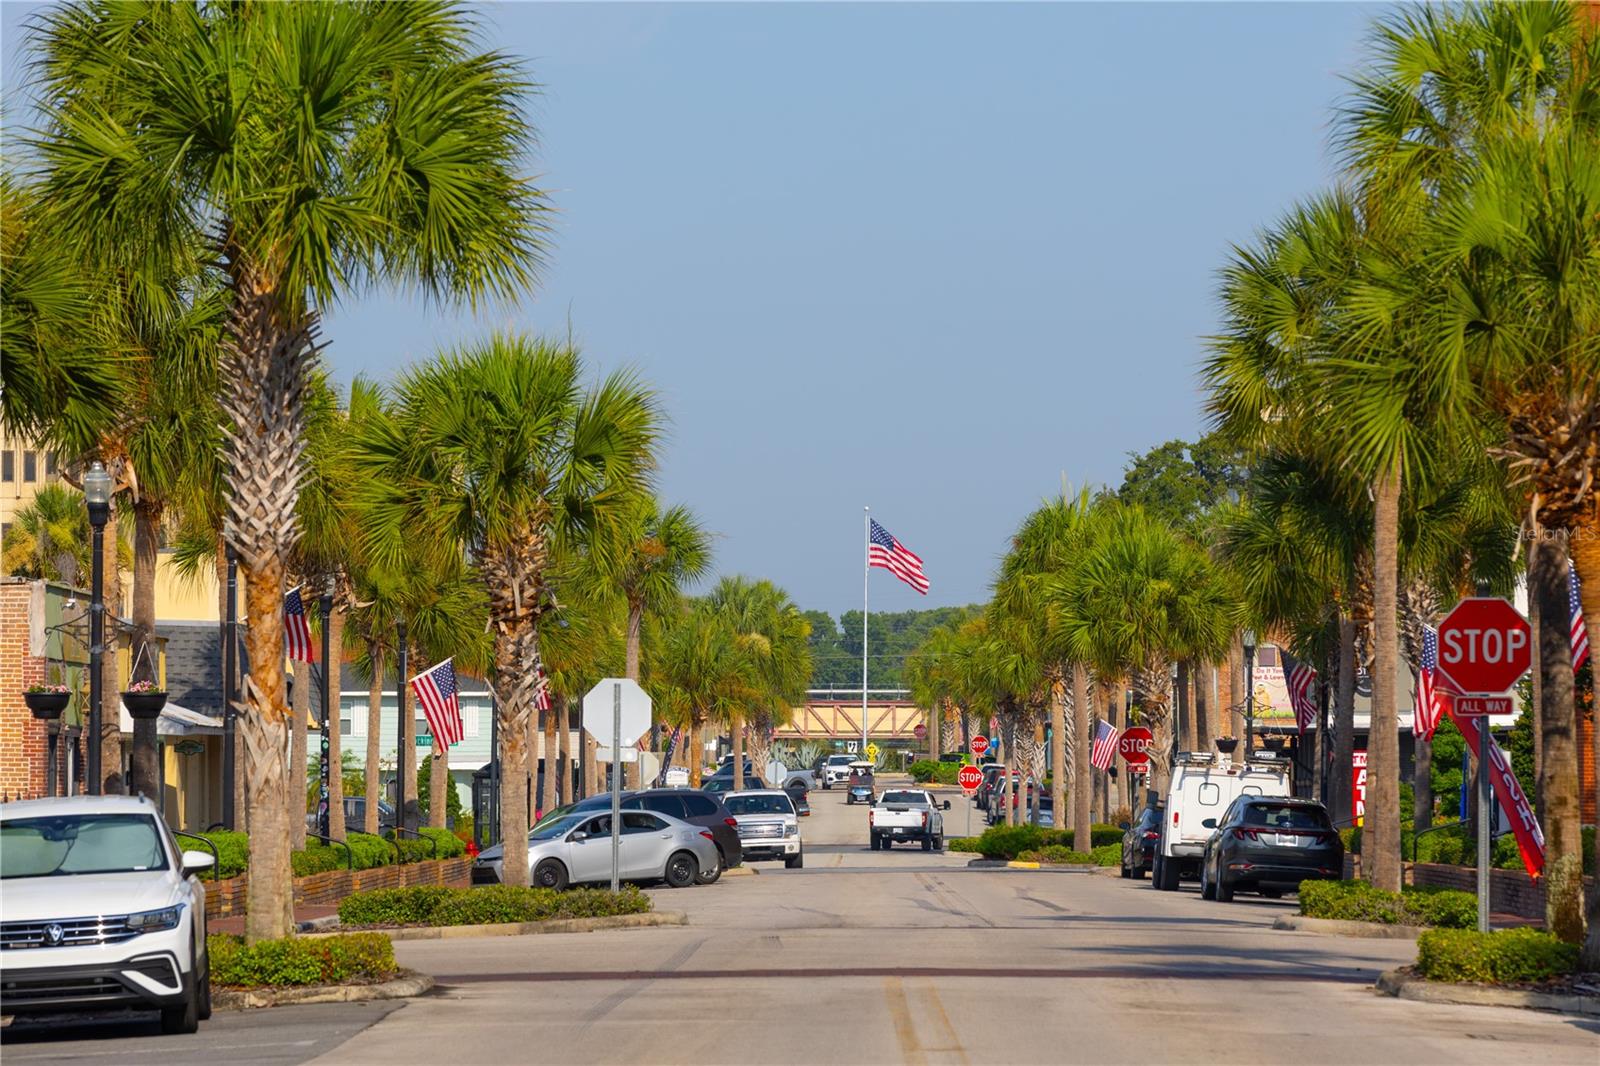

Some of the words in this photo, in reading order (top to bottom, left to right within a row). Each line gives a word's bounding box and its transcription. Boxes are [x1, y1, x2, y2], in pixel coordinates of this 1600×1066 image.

[1443, 628, 1526, 664] STOP
[1460, 700, 1482, 712] ALL
[1484, 701, 1508, 712] WAY
[972, 741, 987, 749] STOP
[960, 772, 981, 783] STOP
